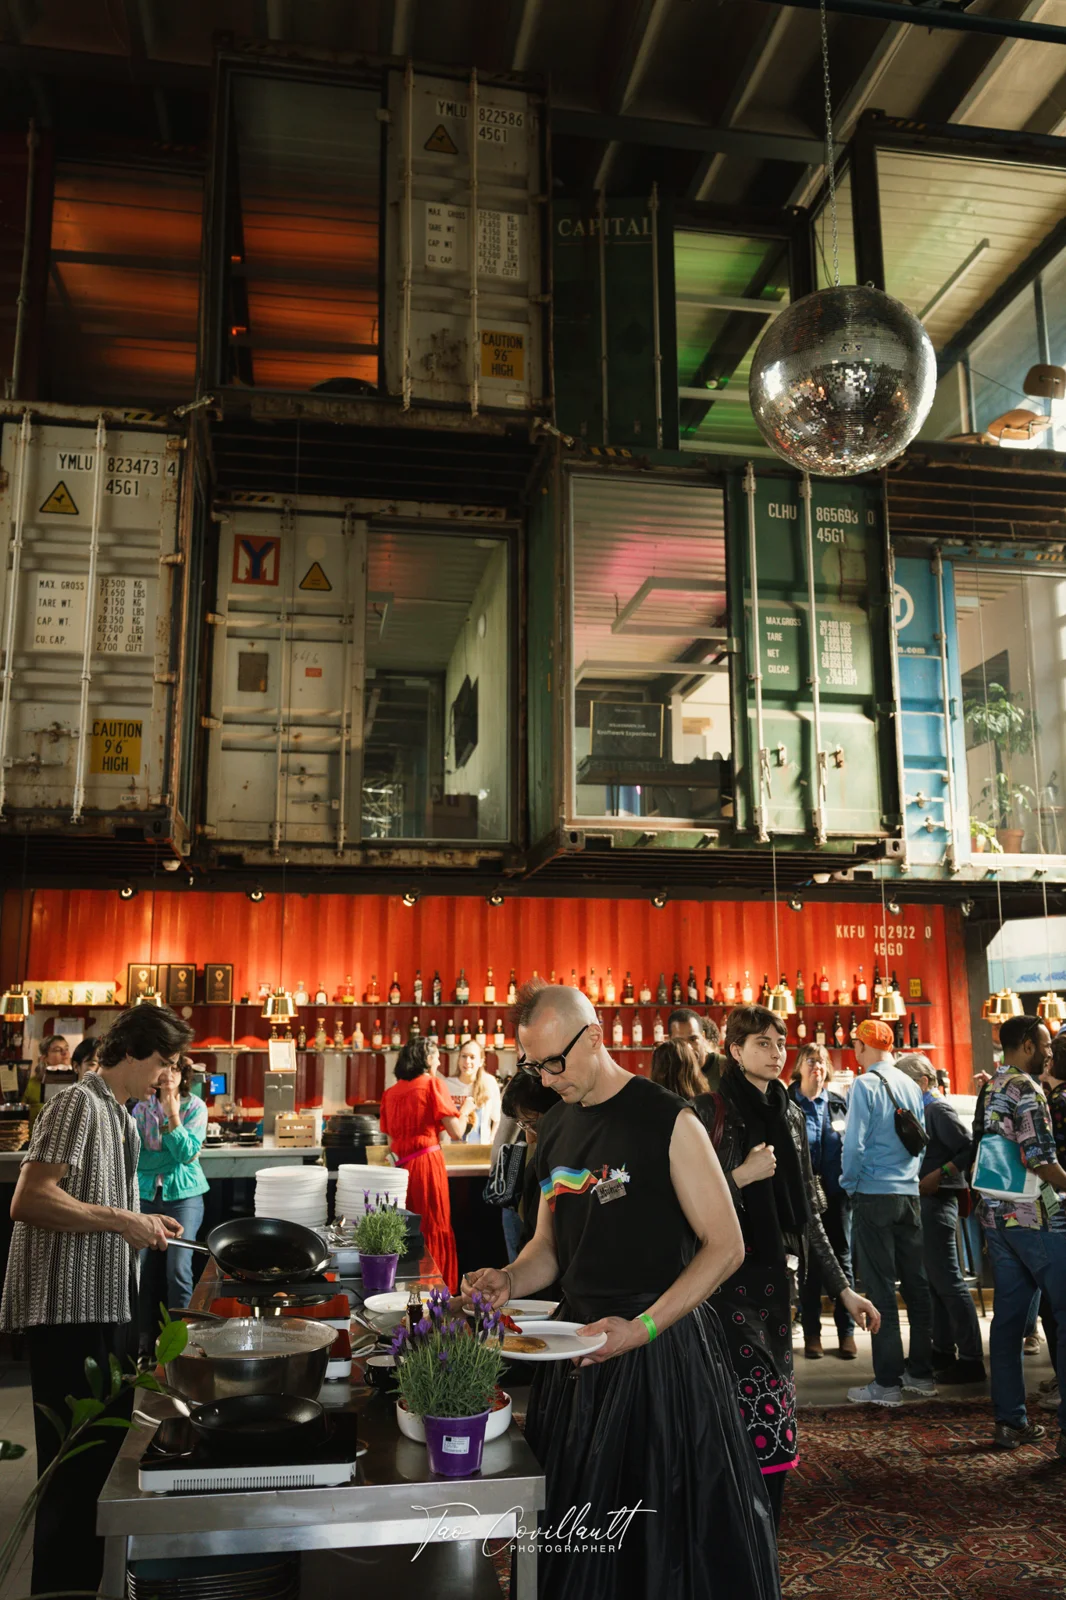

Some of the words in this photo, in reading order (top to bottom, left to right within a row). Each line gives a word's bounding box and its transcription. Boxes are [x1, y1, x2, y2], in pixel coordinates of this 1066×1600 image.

[438, 101, 467, 118] YMLU
[479, 108, 522, 127] 822586
[479, 127, 507, 142] 45G1
[558, 216, 652, 237] CAPITAL
[482, 332, 522, 350] CAUTION
[492, 362, 514, 376] HIGH
[59, 454, 92, 470] YMLU
[107, 458, 158, 475] 823473
[168, 462, 176, 476] 4
[106, 480, 138, 496] 45G1
[768, 502, 798, 520] CLHU
[816, 528, 845, 543] 45G1
[61, 581, 84, 590] GROSS
[134, 580, 142, 588] KG
[134, 590, 145, 598] LBS
[38, 598, 56, 608] TARE
[133, 599, 142, 607] KG
[132, 608, 144, 616] LBS
[132, 616, 140, 625] KG
[132, 626, 144, 634] LBS
[767, 632, 782, 642] TARE
[767, 648, 780, 658] NET
[92, 722, 142, 738] CAUTION
[102, 756, 128, 772] HIGH
[836, 924, 865, 938] KKFU
